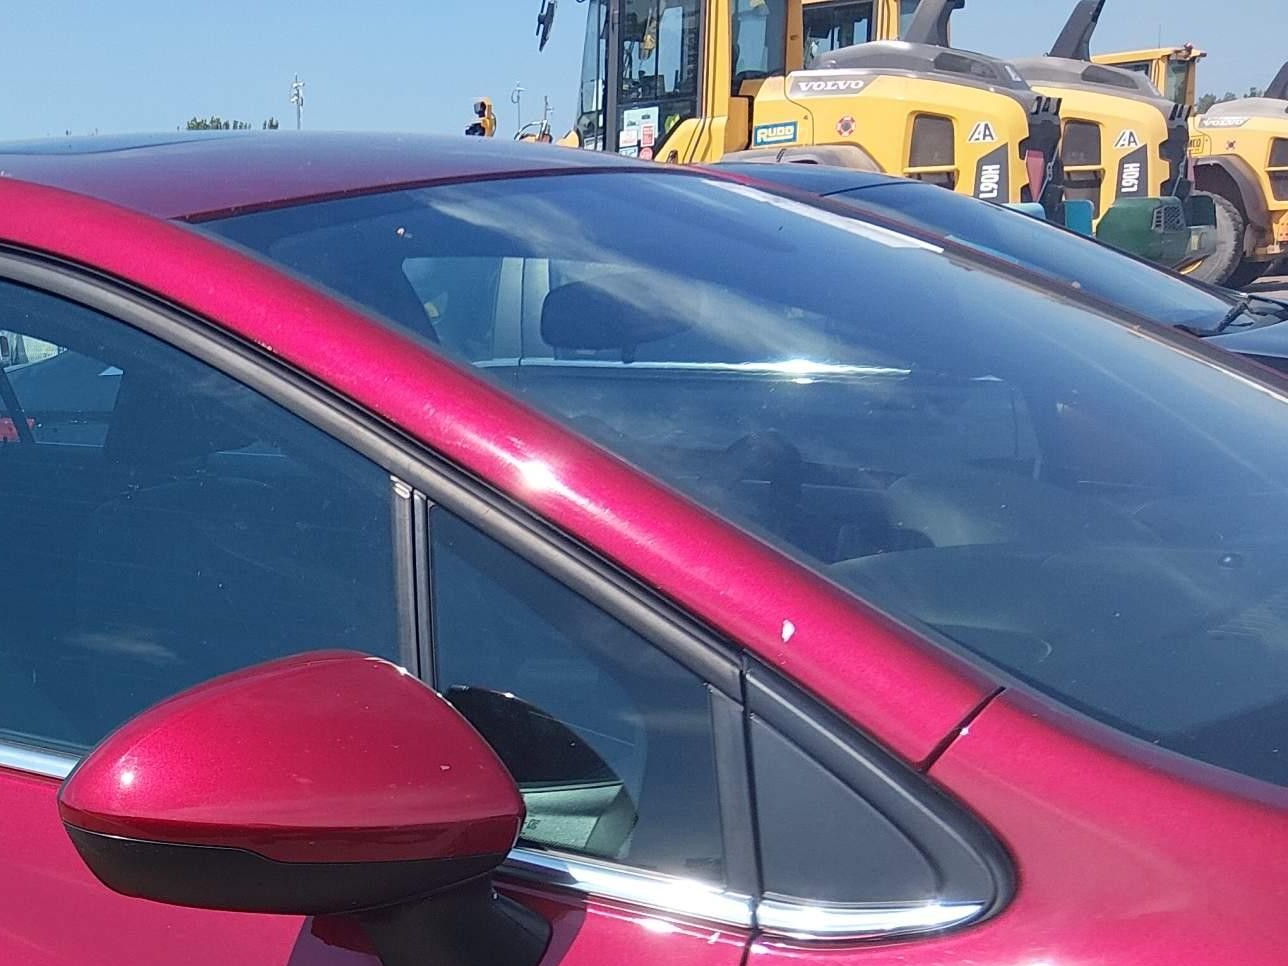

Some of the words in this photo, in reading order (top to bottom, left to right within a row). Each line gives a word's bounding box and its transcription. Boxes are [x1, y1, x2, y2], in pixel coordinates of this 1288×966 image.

[798, 79, 864, 91] VOLVO
[1202, 118, 1244, 127] VOLVO
[757, 125, 795, 142] RUDD
[979, 164, 1000, 200] L90H
[1121, 163, 1141, 192] L90H
